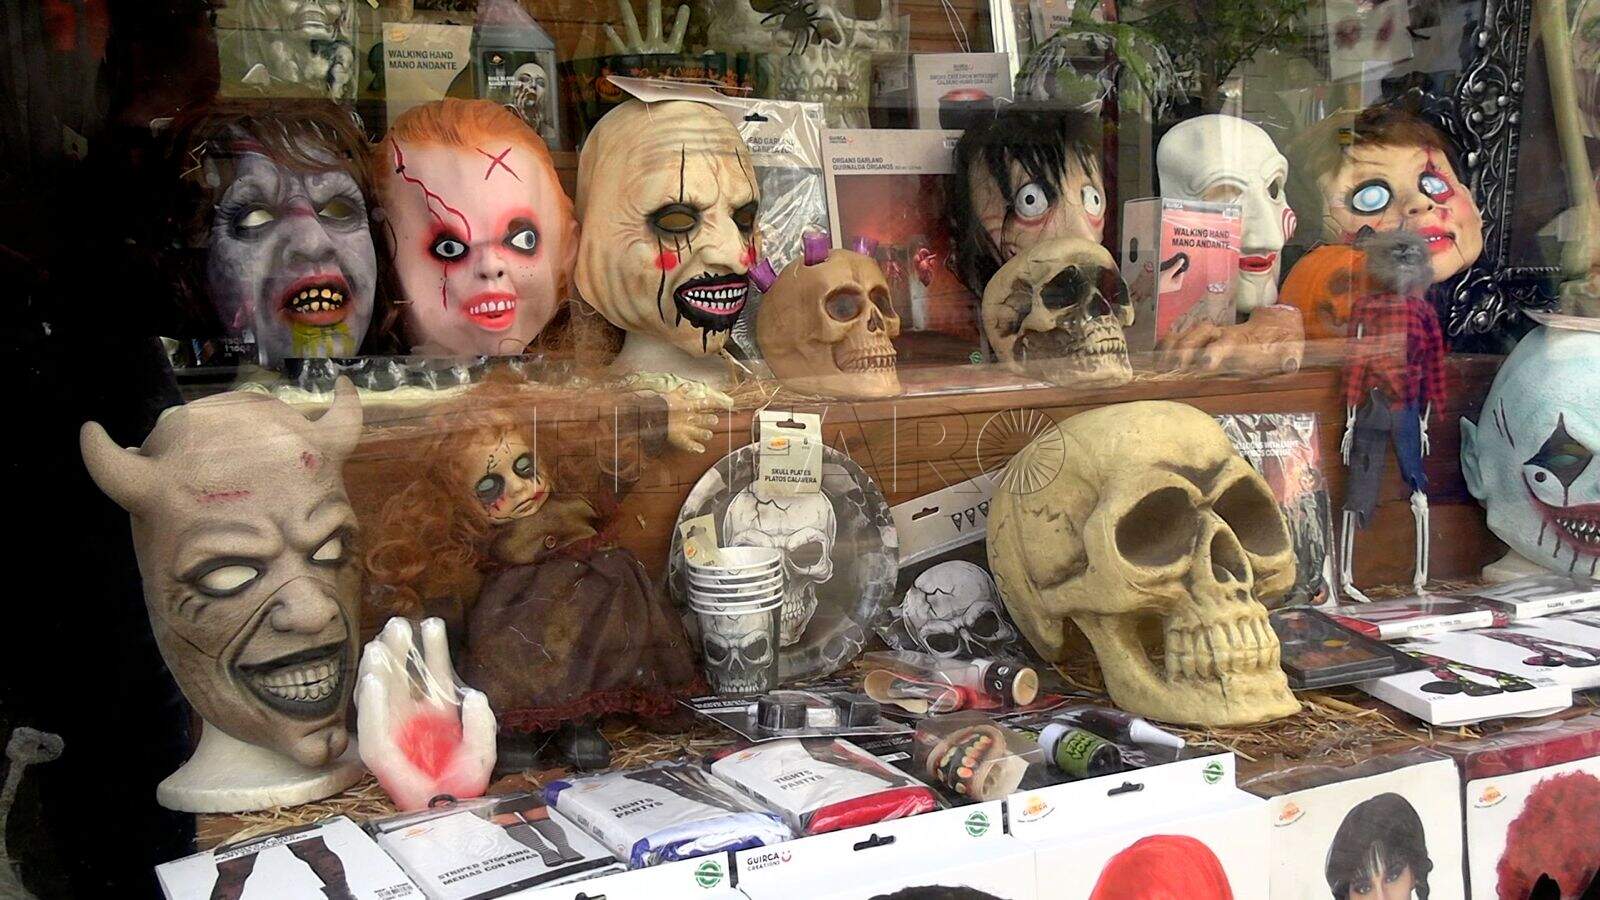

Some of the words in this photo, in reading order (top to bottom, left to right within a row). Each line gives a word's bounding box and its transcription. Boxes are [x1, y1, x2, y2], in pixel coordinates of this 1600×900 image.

[388, 50, 428, 59] WALKING
[429, 51, 453, 59] HAND
[389, 61, 415, 69] MANO
[417, 61, 456, 70] ANDANTE
[1174, 227, 1208, 238] WALKING
[1209, 230, 1229, 239] HAND
[1172, 238, 1195, 247] MANO
[1196, 239, 1231, 249] ANDANTE
[790, 469, 811, 477] PLATES
[787, 476, 817, 484] CALAVERA
[774, 769, 813, 784] TIGHTS
[780, 775, 824, 790] PANTYS
[611, 798, 654, 812] TIGHTS
[615, 802, 663, 818] PANTYS
[438, 863, 480, 880] STRIPED
[482, 849, 530, 866] STOCKING
[747, 852, 780, 865] GUIRCA
[442, 870, 482, 886] MEDIAS
[485, 863, 506, 872] CON
[507, 853, 539, 866] RAYAS
